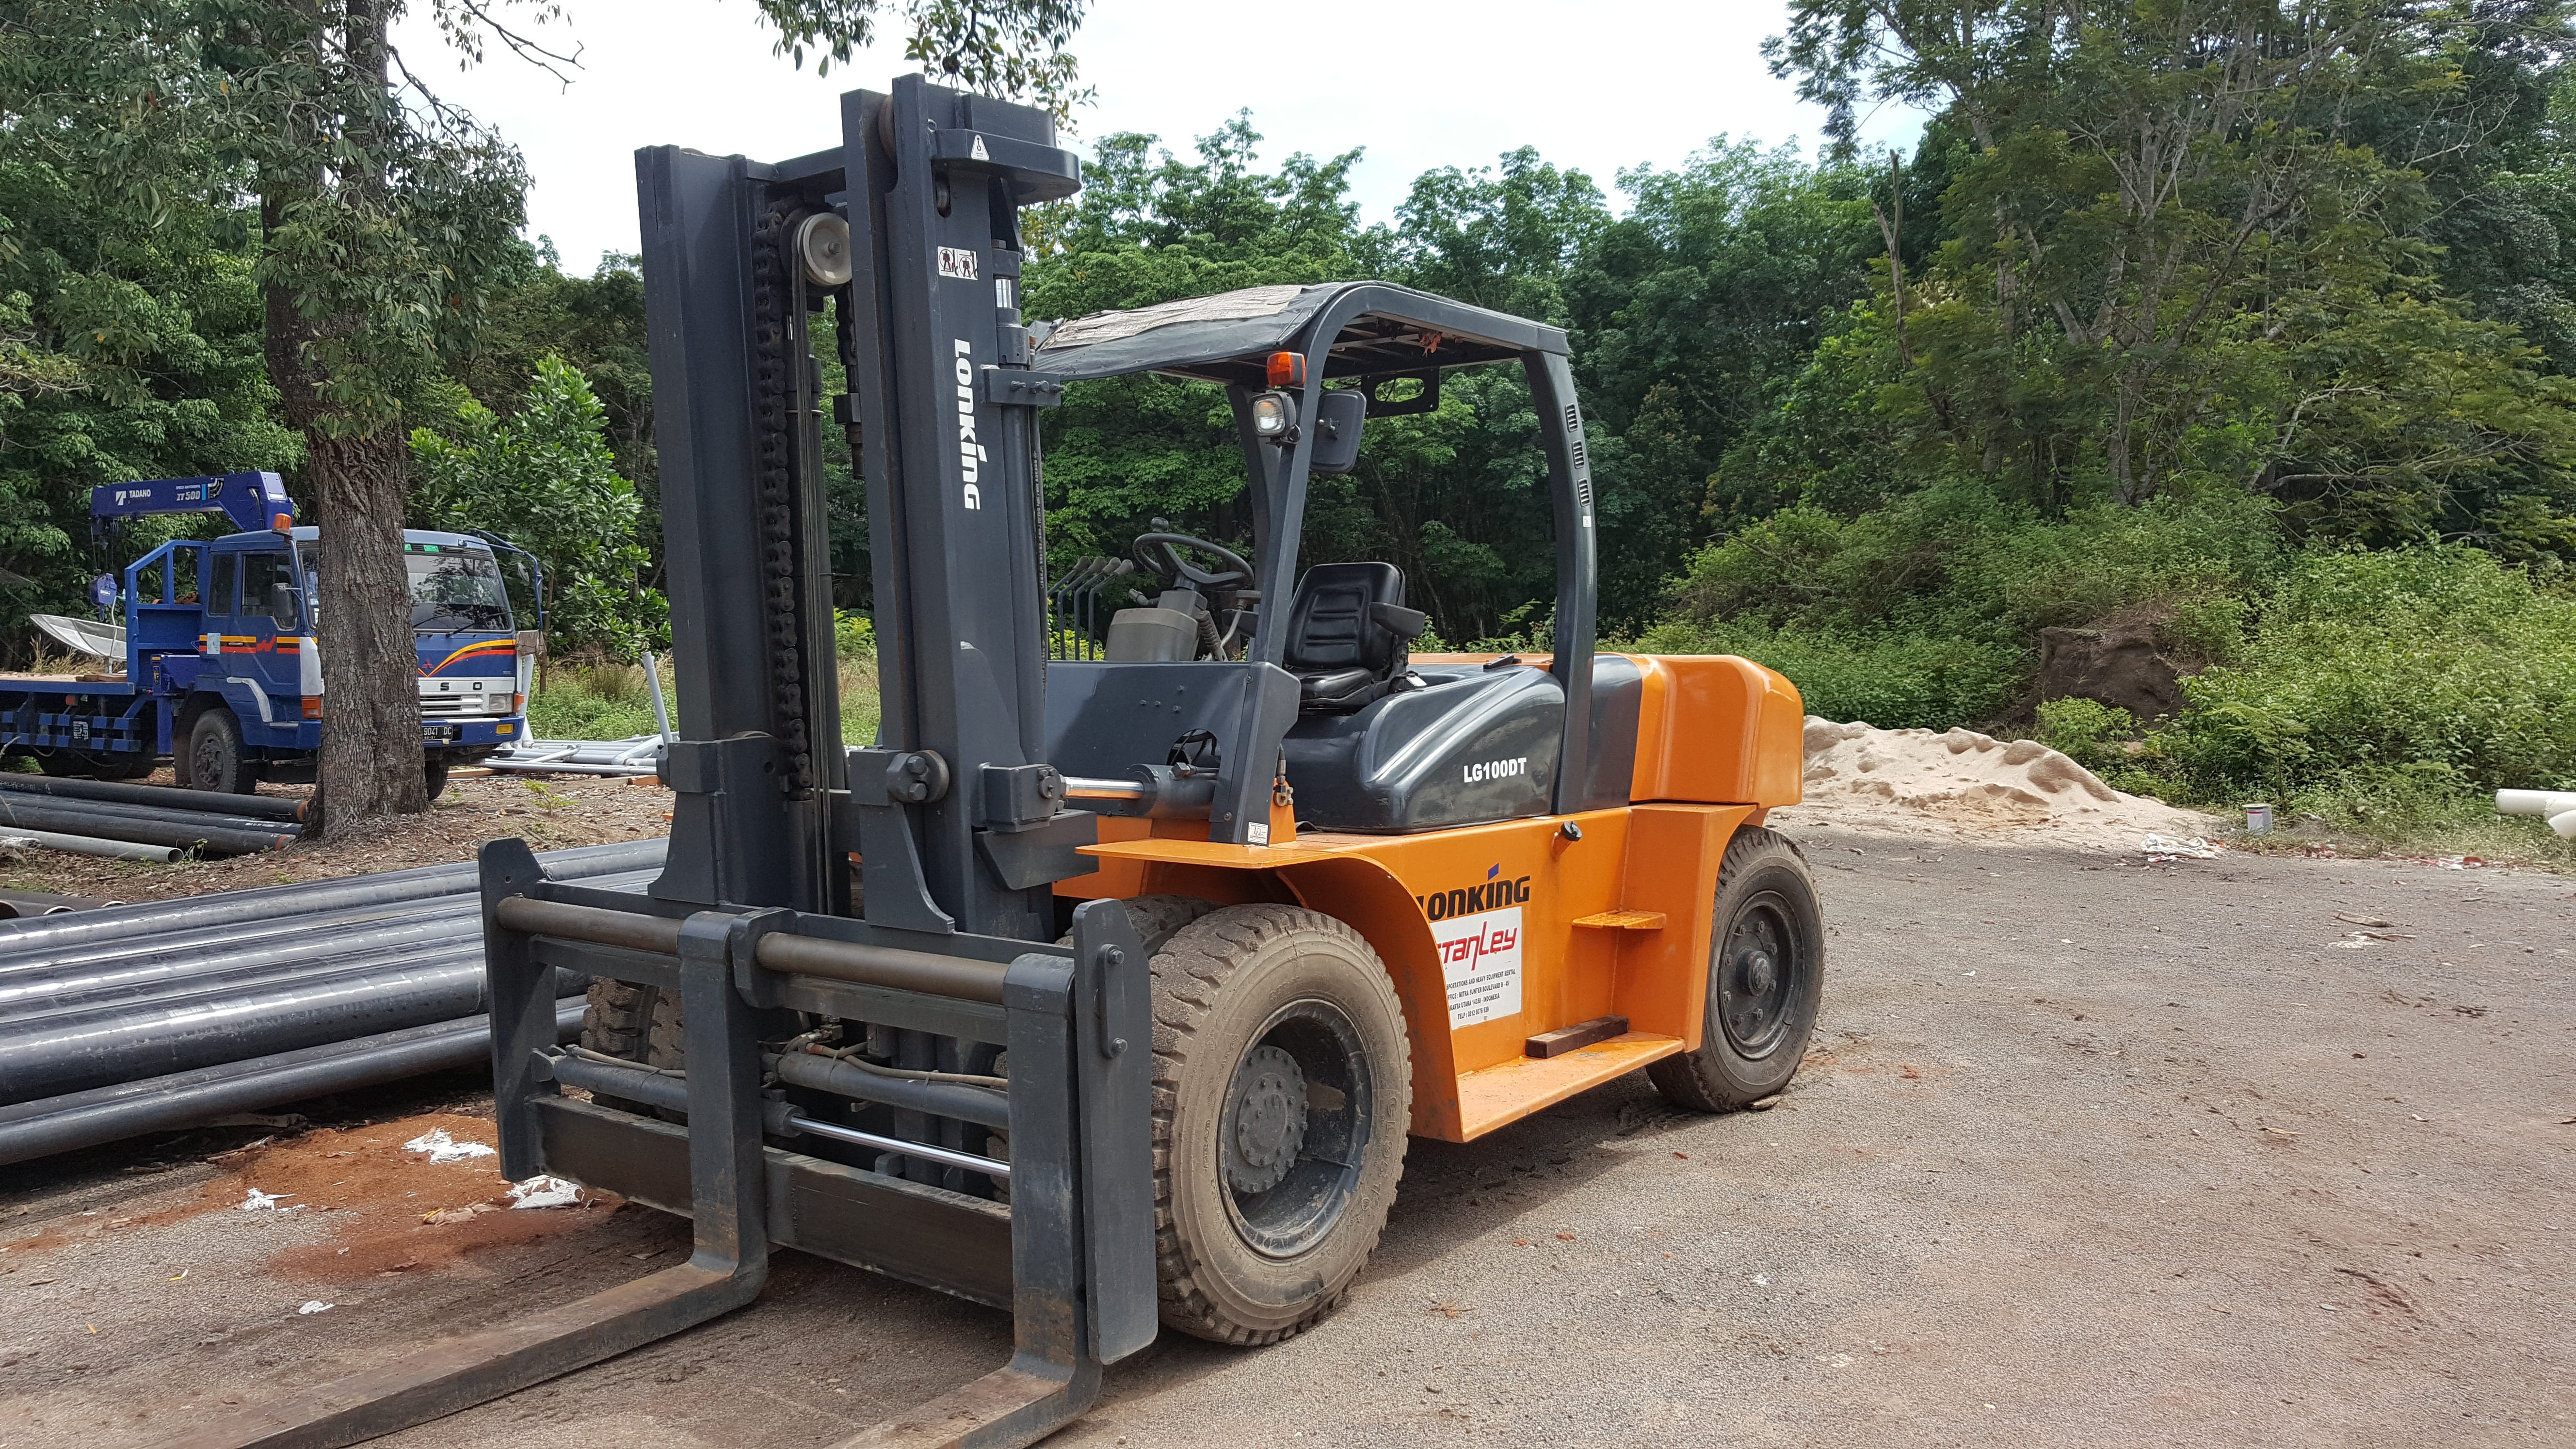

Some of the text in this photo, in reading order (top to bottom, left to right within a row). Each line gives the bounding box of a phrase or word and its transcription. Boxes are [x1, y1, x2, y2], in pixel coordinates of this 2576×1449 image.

[129, 489, 151, 498] TADANO
[186, 490, 200, 500] 500
[440, 682, 483, 691] SO
[1464, 757, 1527, 783] LG100DT
[1447, 980, 1468, 990] SPORTATIONS
[1486, 971, 1504, 980] EQUIPMENT
[1482, 982, 1500, 992] BOULEVARD
[1483, 993, 1500, 1002] INDONESIA
